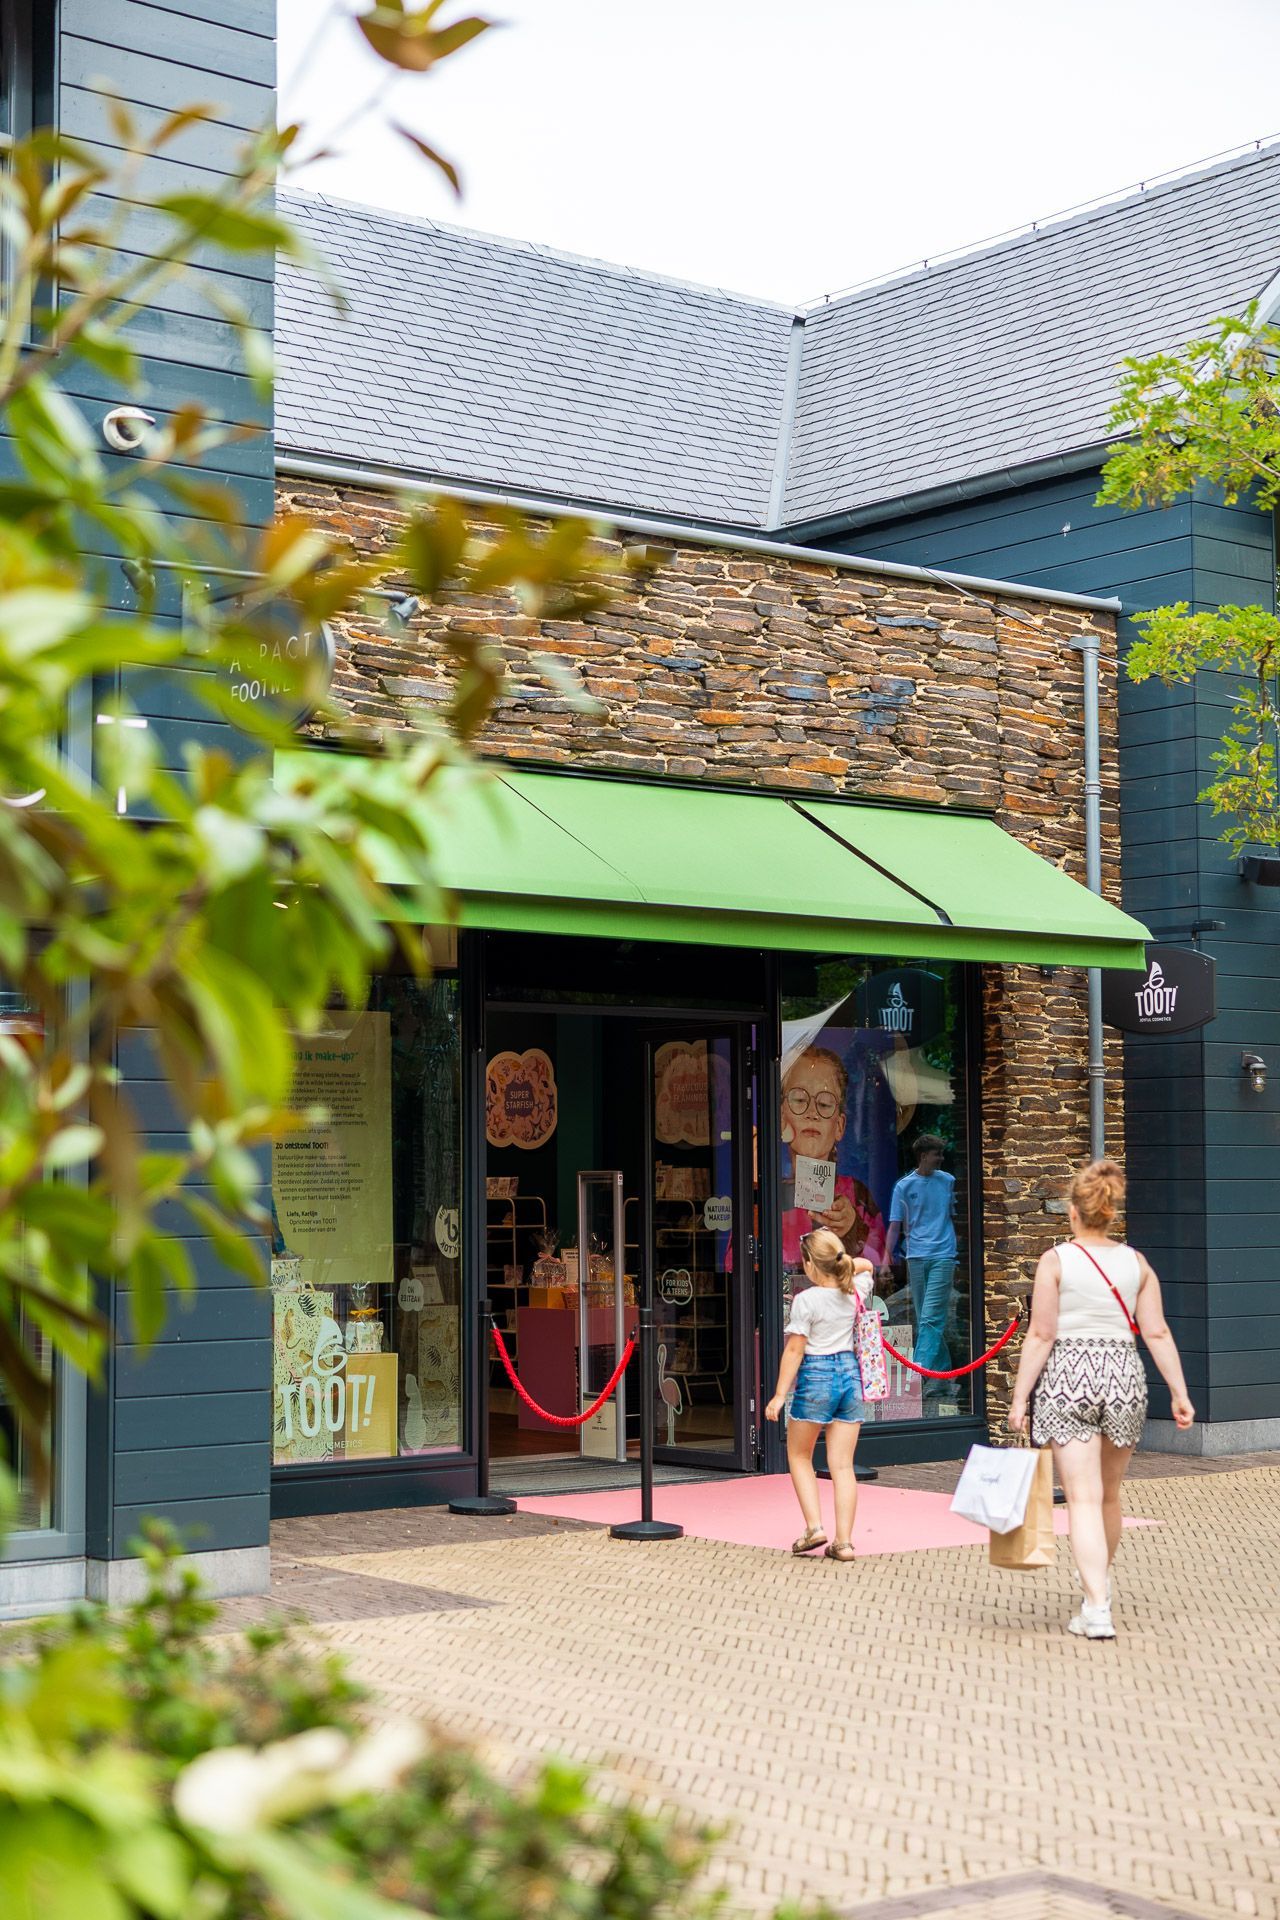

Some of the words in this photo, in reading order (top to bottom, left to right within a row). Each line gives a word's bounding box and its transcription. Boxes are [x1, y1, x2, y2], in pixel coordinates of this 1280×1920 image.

[1134, 987, 1177, 1017] TOOT!
[510, 1090, 529, 1099] SUPER
[506, 1101, 534, 1110] STARFISH
[280, 1374, 376, 1440] TOOT!
